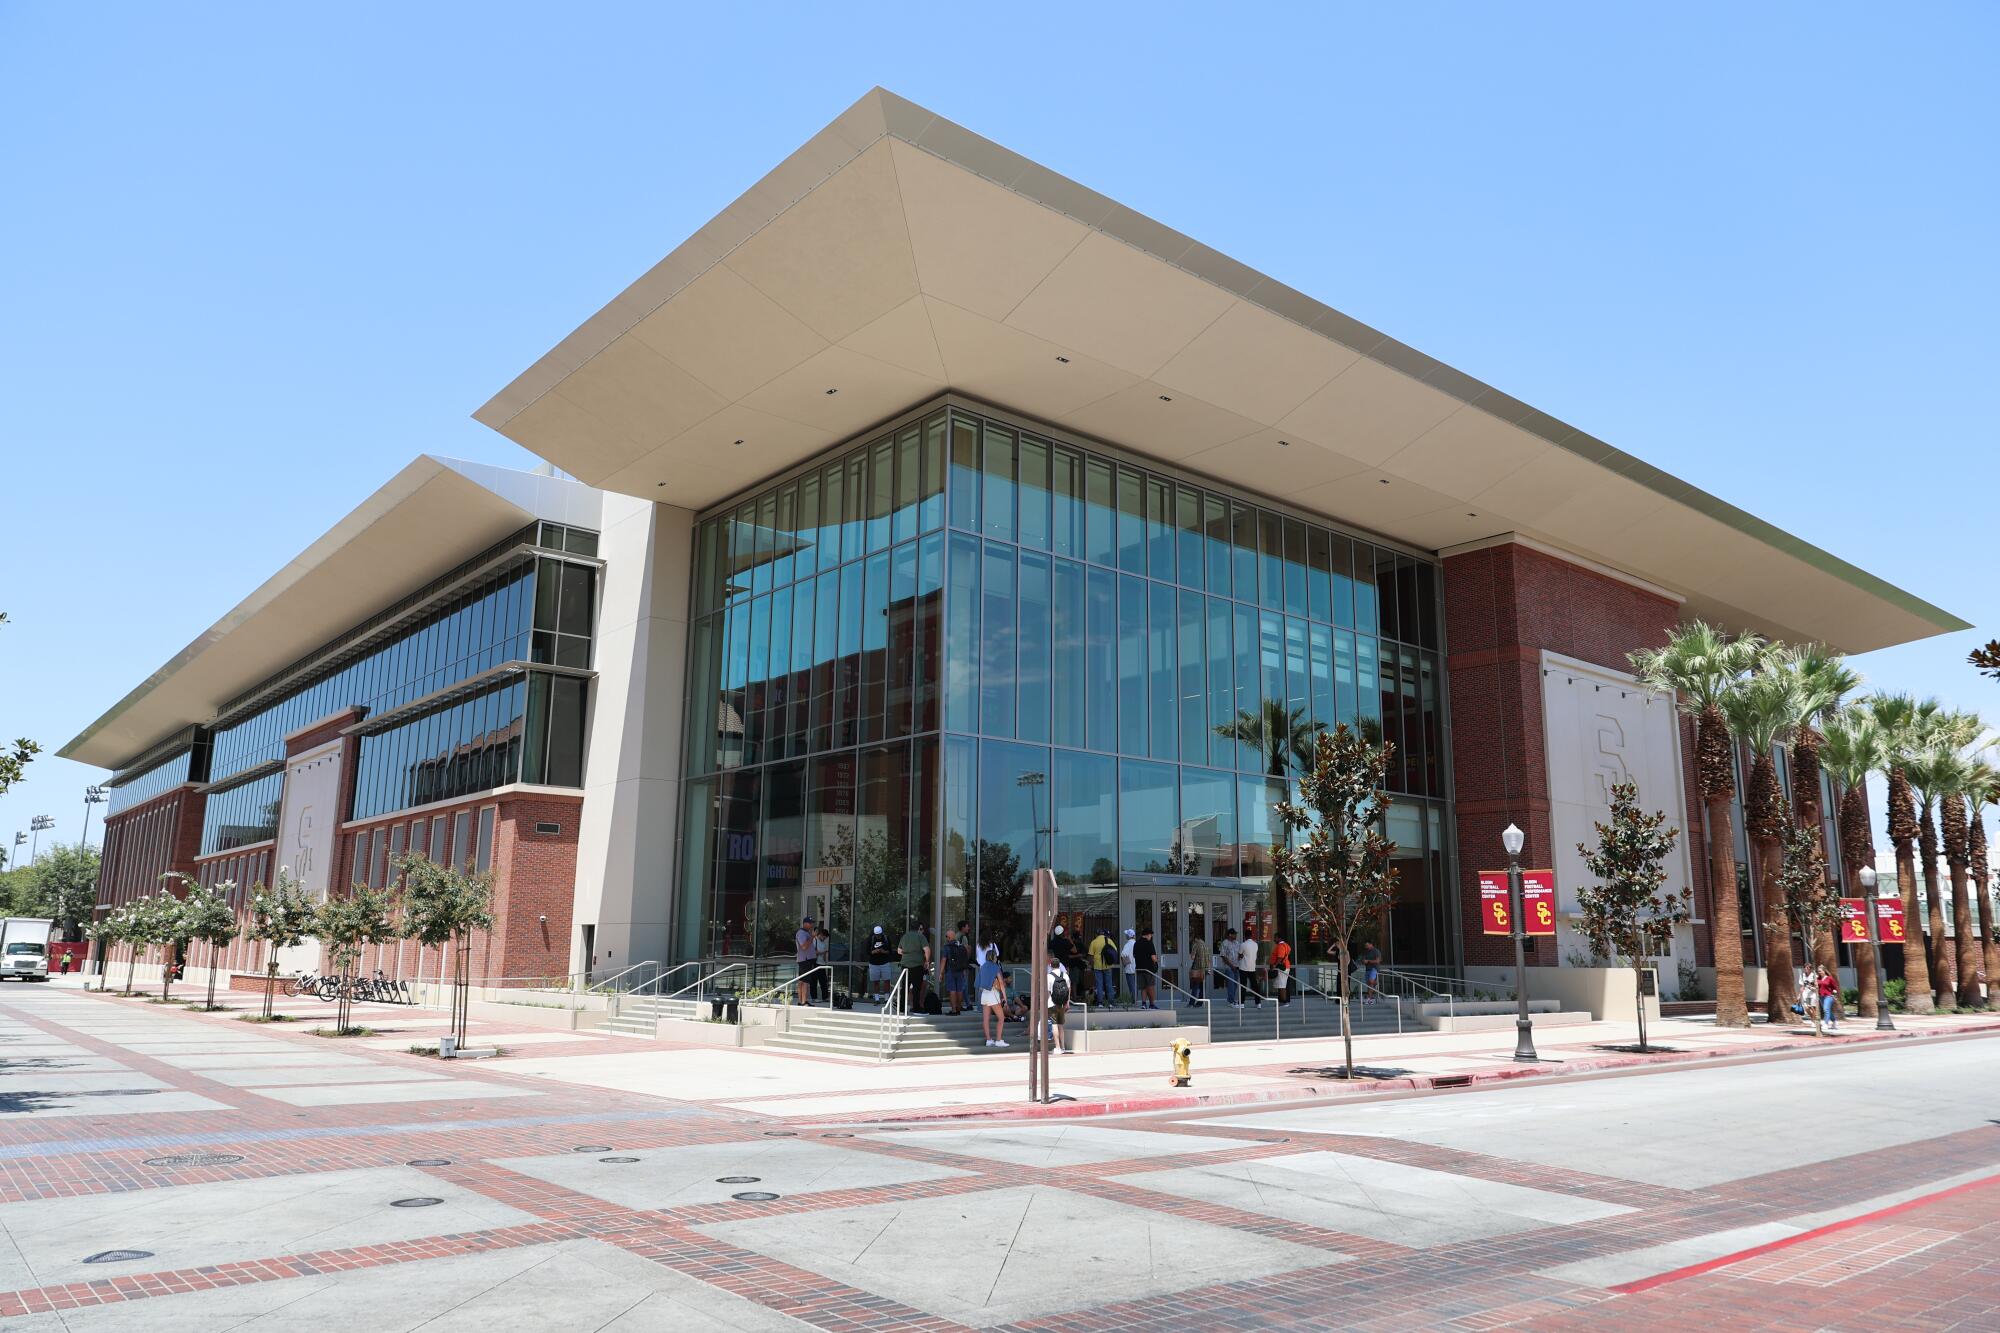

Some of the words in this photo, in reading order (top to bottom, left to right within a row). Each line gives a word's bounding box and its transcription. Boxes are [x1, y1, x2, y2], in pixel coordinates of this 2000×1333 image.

[1493, 901, 1508, 925] SC
[1536, 901, 1552, 925] SC
[1851, 919, 1866, 937] SC
[1889, 919, 1903, 937] SC
